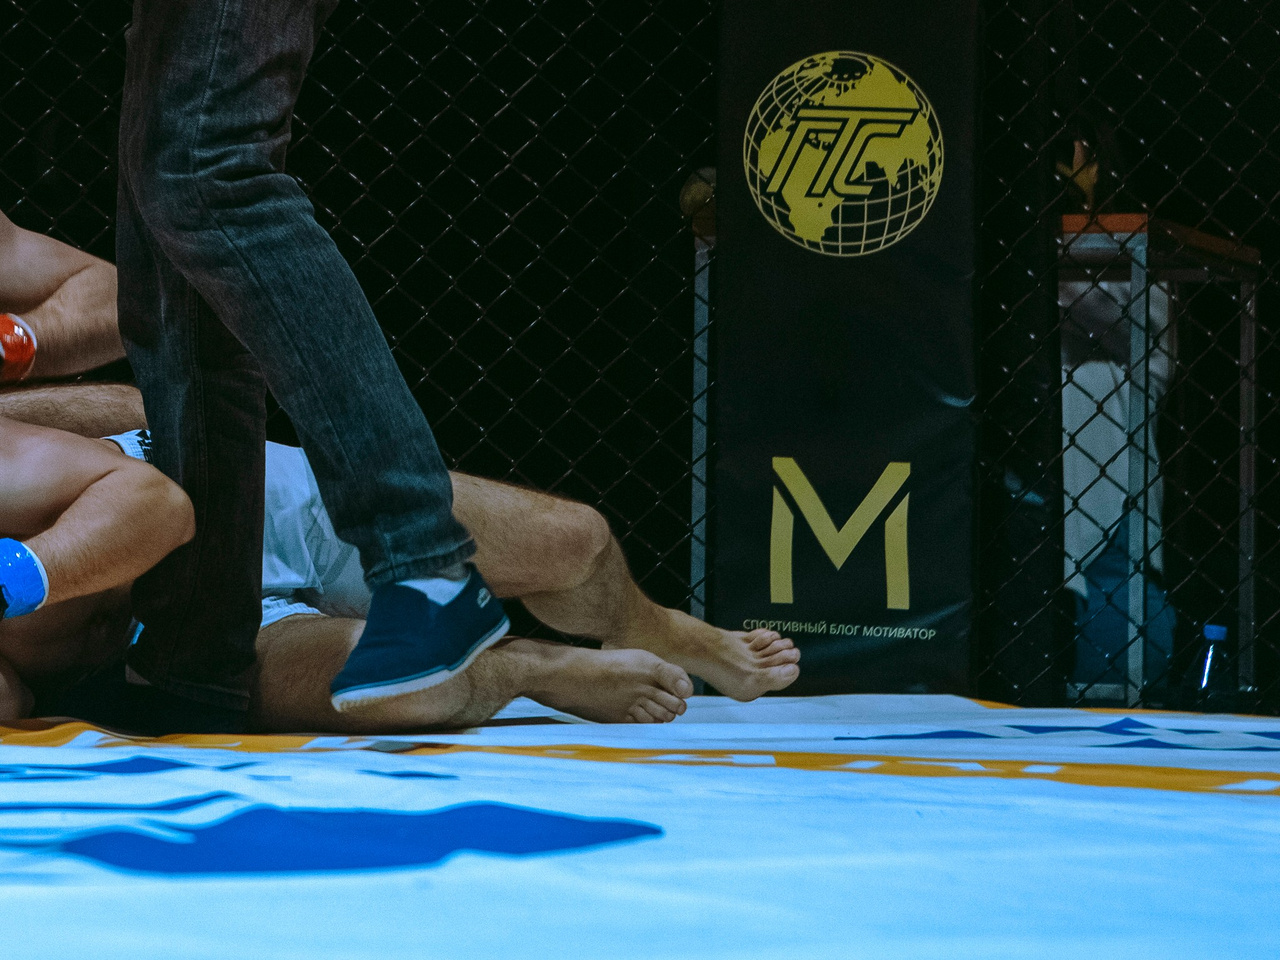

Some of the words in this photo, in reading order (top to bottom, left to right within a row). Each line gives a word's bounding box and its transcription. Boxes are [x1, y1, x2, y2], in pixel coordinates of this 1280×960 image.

[742, 618, 827, 634] СПОРТИВНЫЙ
[829, 623, 861, 636] БЛОГ
[862, 625, 937, 641] МОТИВАТОР
